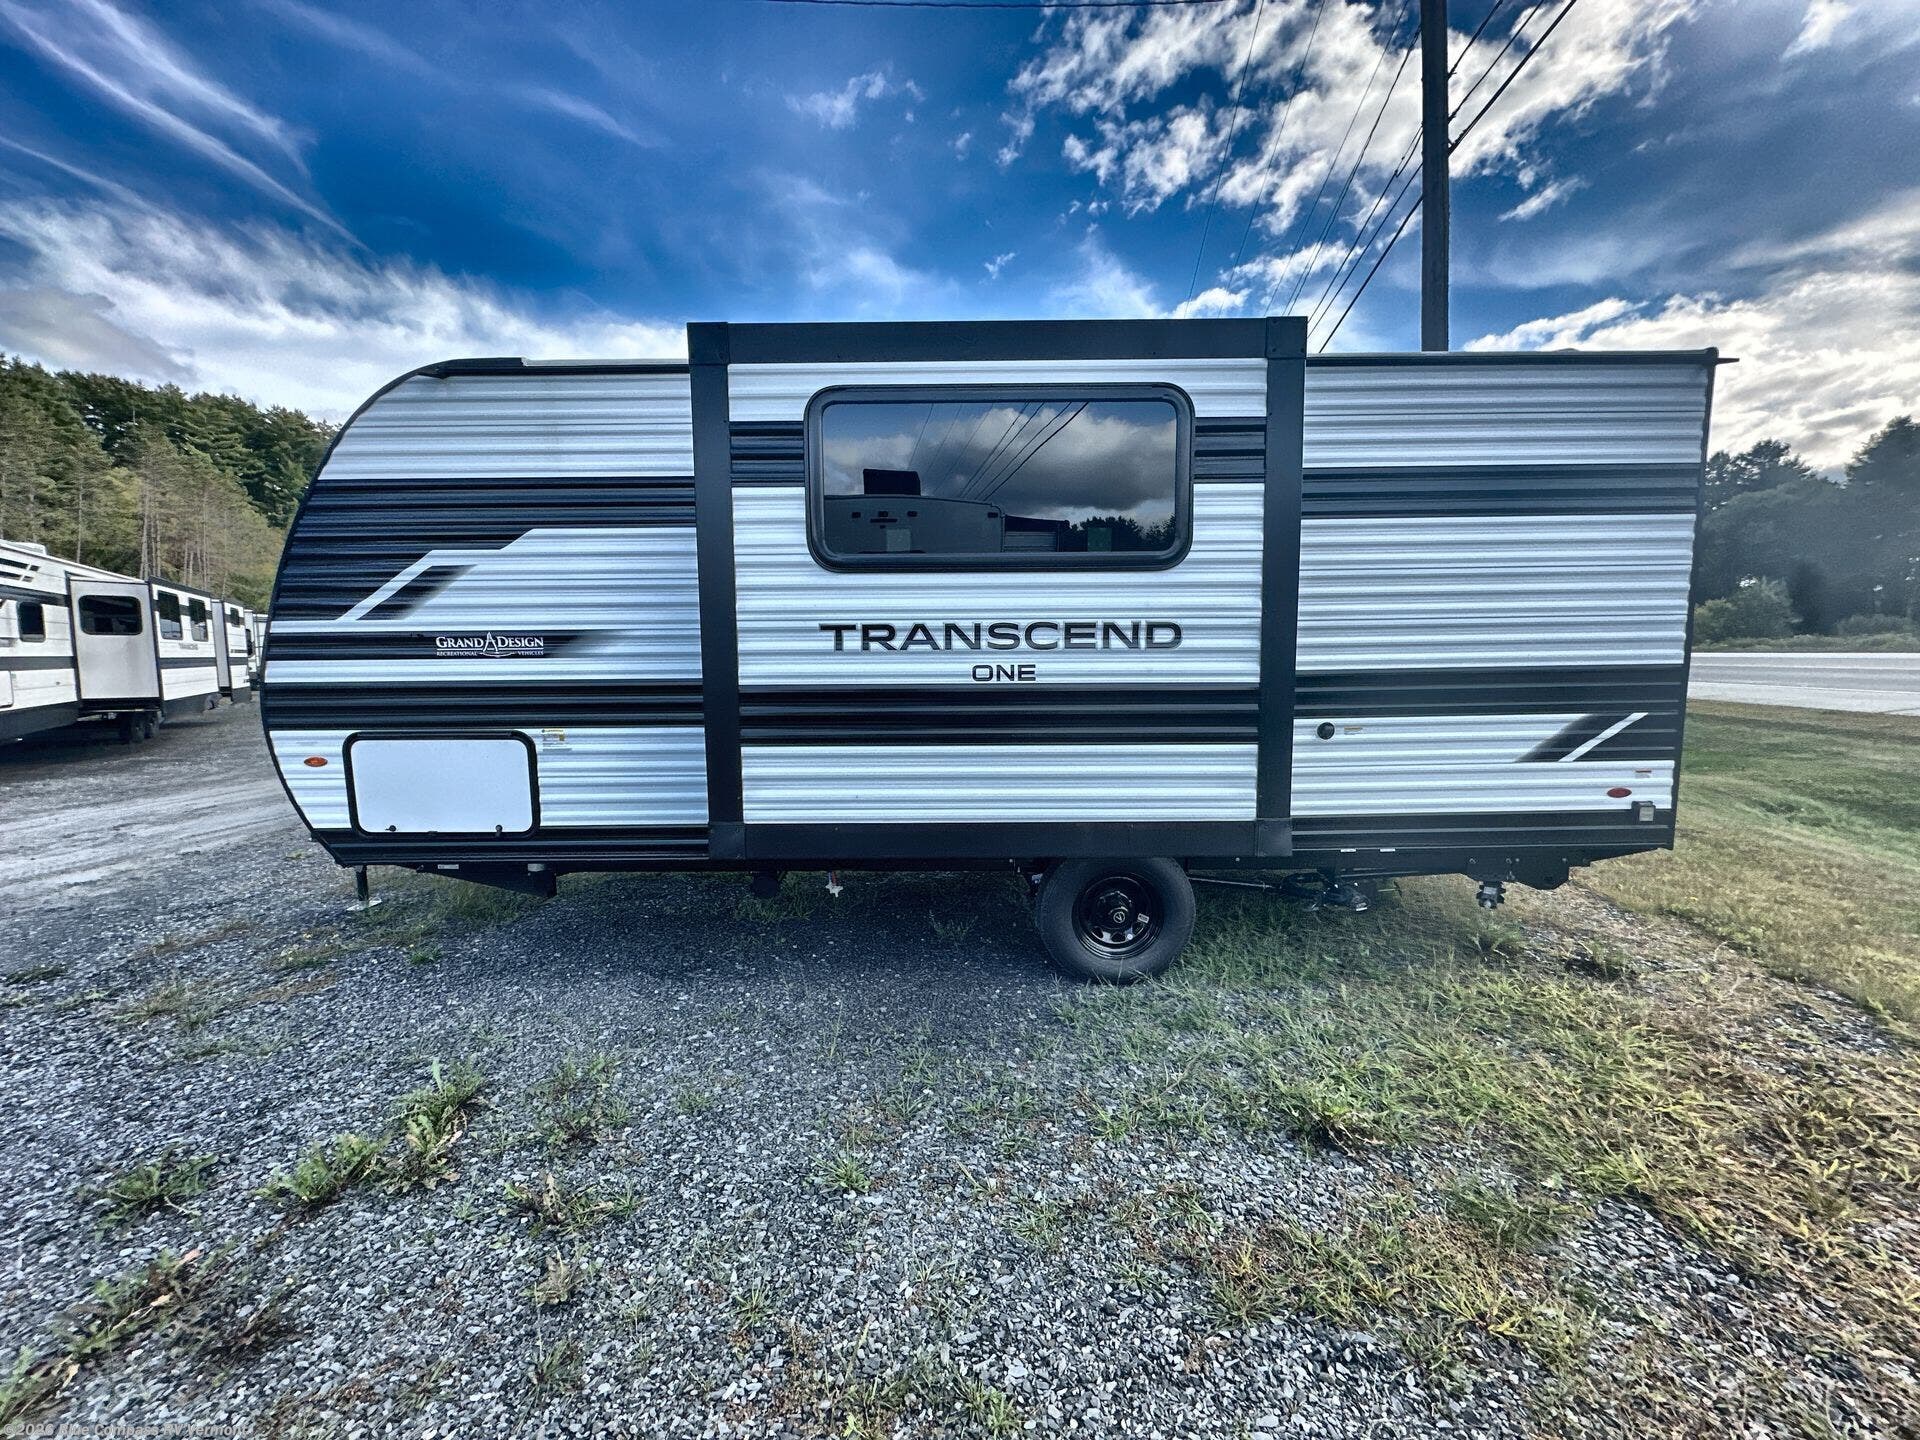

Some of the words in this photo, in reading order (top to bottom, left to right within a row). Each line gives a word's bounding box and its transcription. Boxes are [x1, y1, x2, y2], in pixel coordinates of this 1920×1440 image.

[435, 636, 484, 648] GRAND
[496, 636, 545, 648] DESIGN
[818, 621, 1183, 652] TRANSCEND
[971, 664, 1037, 682] ONE
